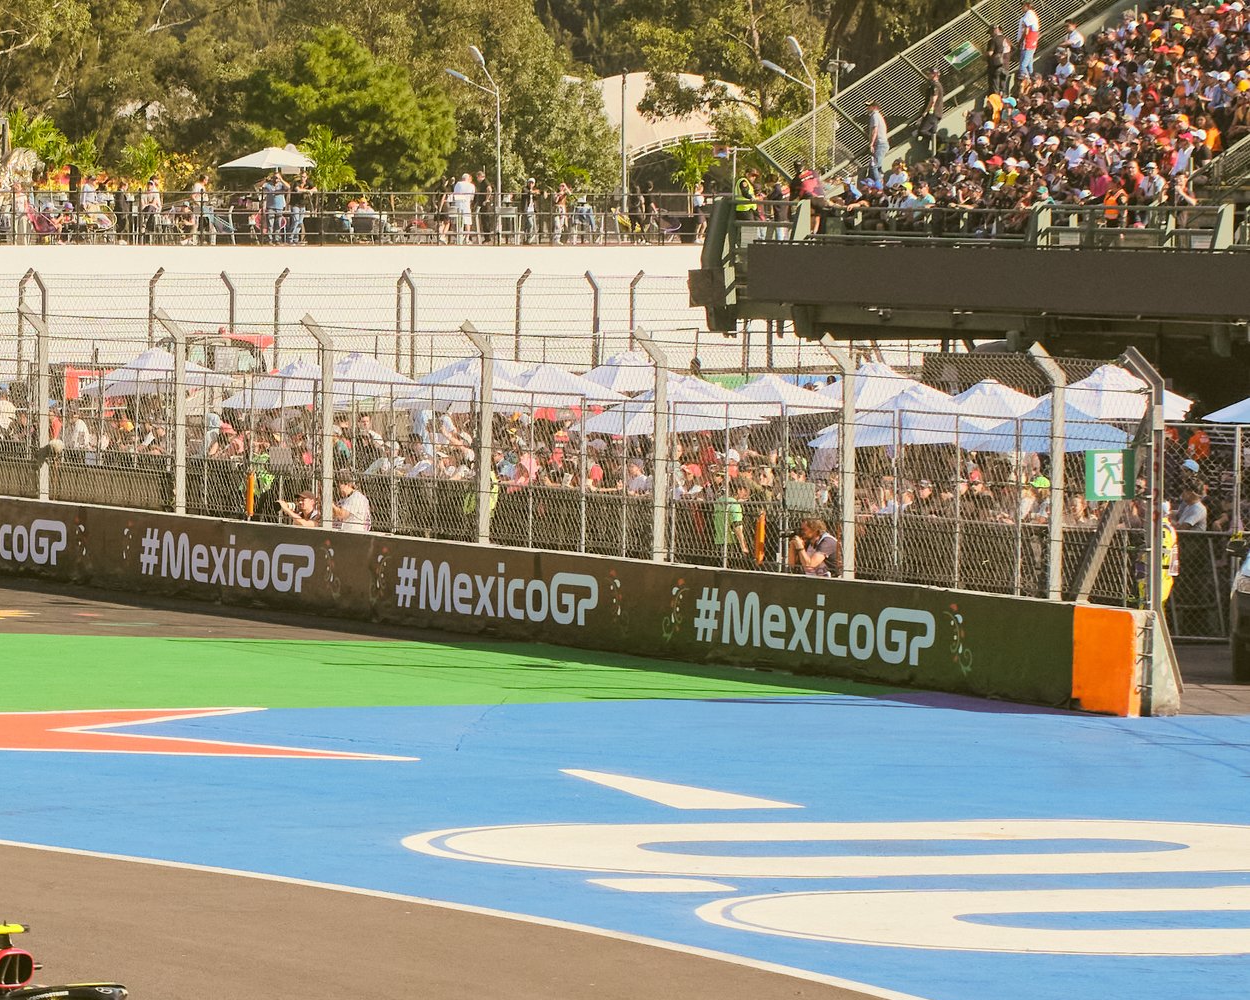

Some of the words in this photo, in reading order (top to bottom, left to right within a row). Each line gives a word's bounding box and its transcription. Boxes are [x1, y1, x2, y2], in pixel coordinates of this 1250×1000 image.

[140, 527, 315, 593] #MexicoGP
[395, 556, 599, 627] #MexicoGP
[694, 587, 937, 666] #MexicoGP
